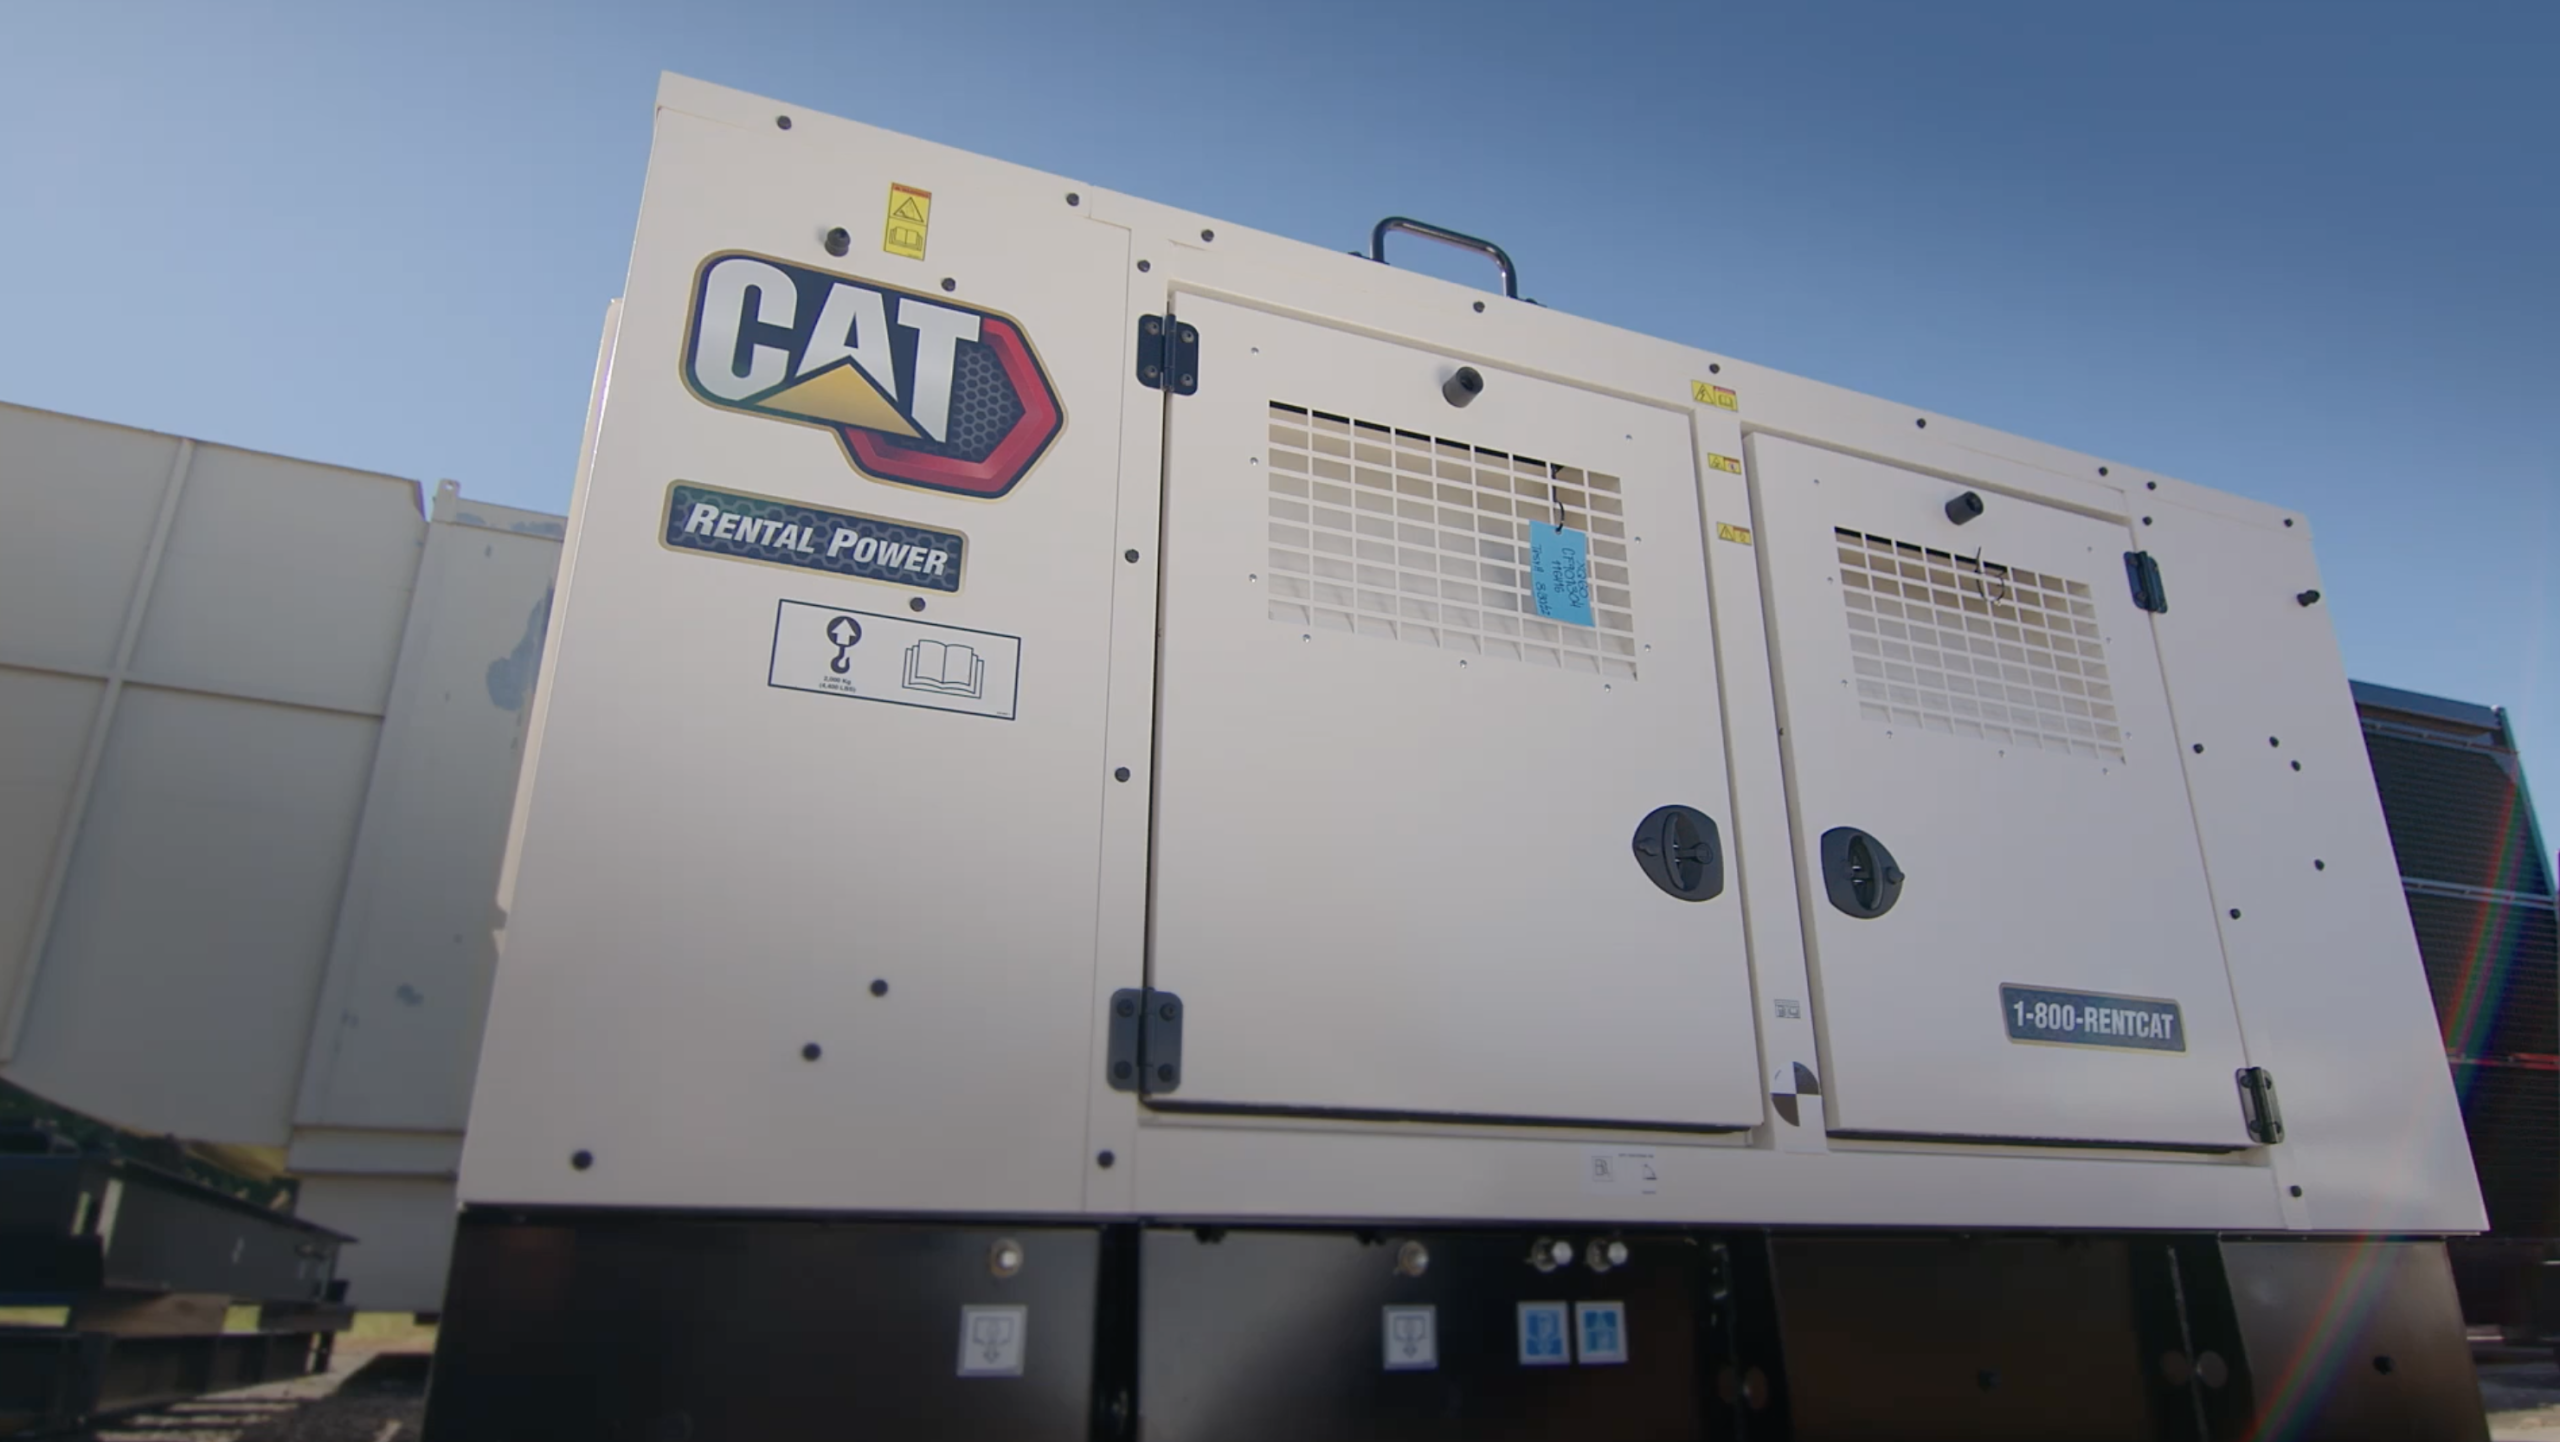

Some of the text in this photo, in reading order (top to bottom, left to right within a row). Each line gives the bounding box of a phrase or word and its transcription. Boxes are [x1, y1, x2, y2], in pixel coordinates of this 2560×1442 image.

[694, 258, 981, 444] CAT
[684, 502, 949, 576] RENTAL POWER
[2013, 1000, 2174, 1040] 1-800-RENTCAT
